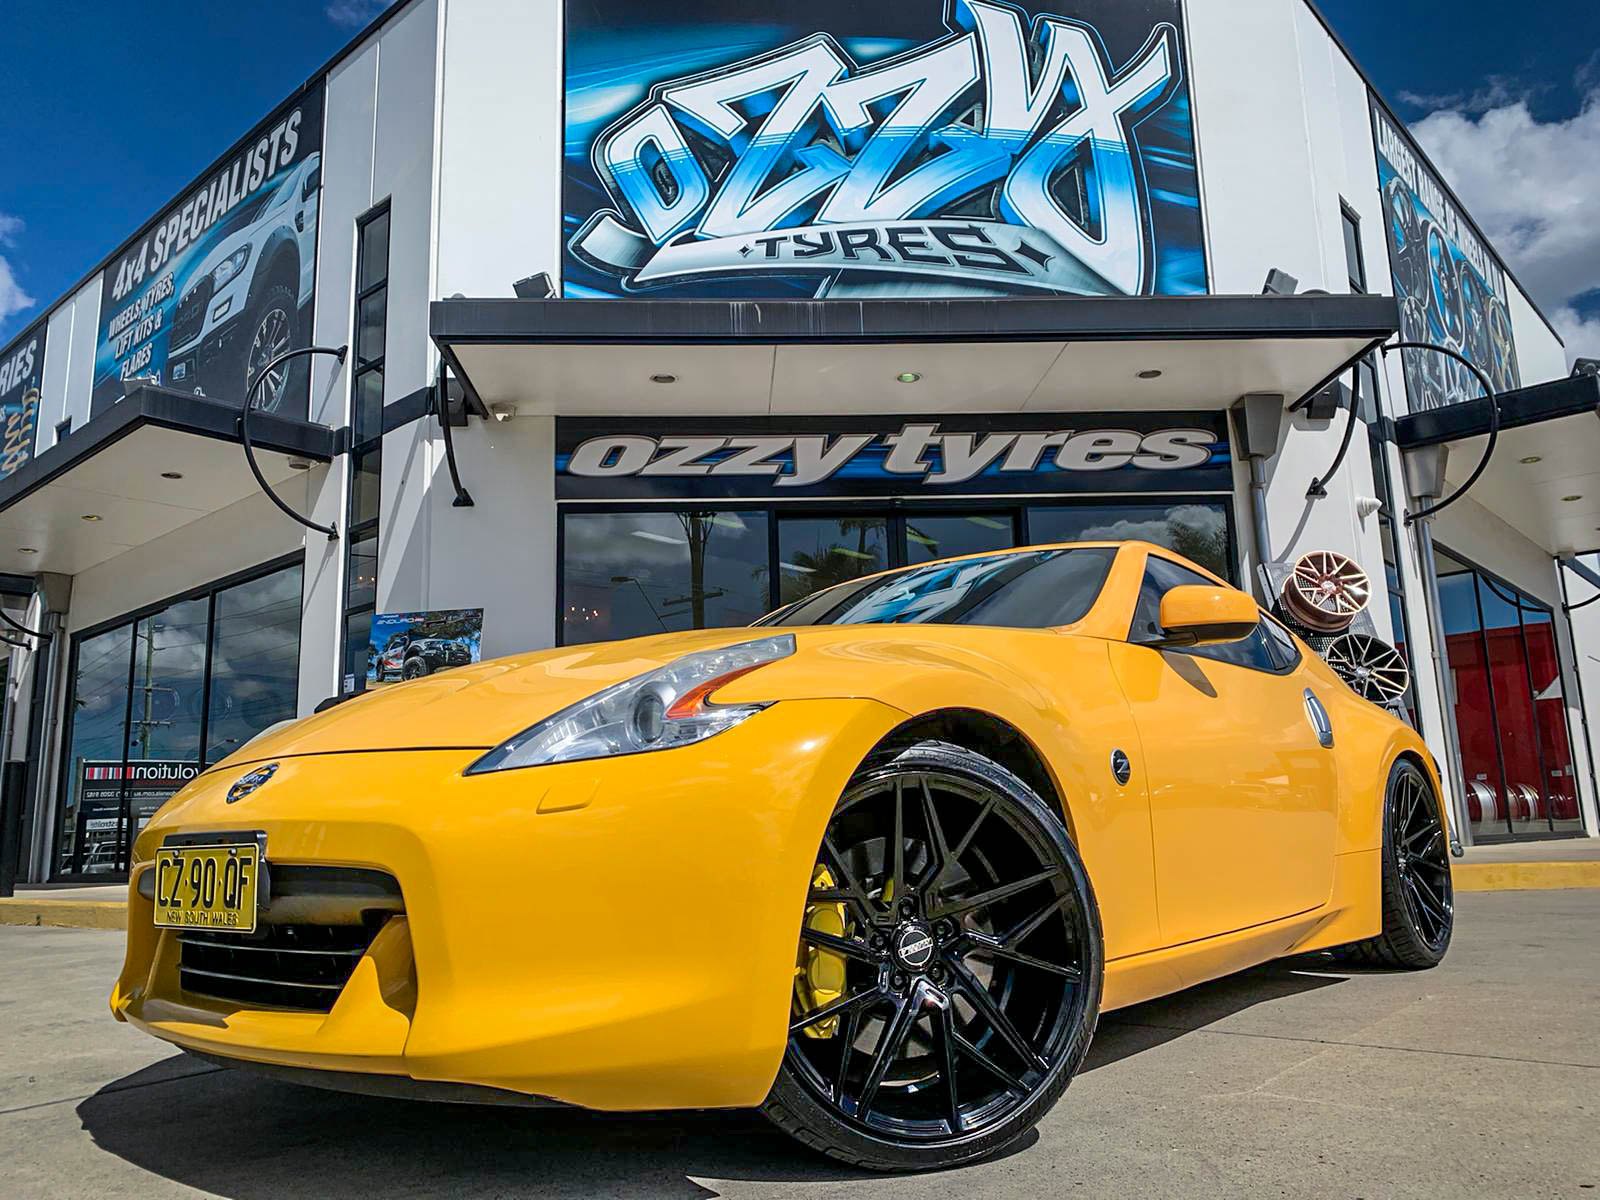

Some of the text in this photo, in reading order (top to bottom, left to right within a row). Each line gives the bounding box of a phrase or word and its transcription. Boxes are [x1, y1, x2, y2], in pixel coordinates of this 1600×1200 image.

[1374, 107, 1418, 196] LARGEST
[112, 110, 302, 301] 4x4 SPECIALISTS
[754, 224, 1033, 276] TYRES
[114, 330, 134, 360] LIFT
[120, 342, 153, 380] FLARES
[567, 422, 1217, 487] ozzy tyres
[167, 911, 239, 926] NEW SOUTH WALES
